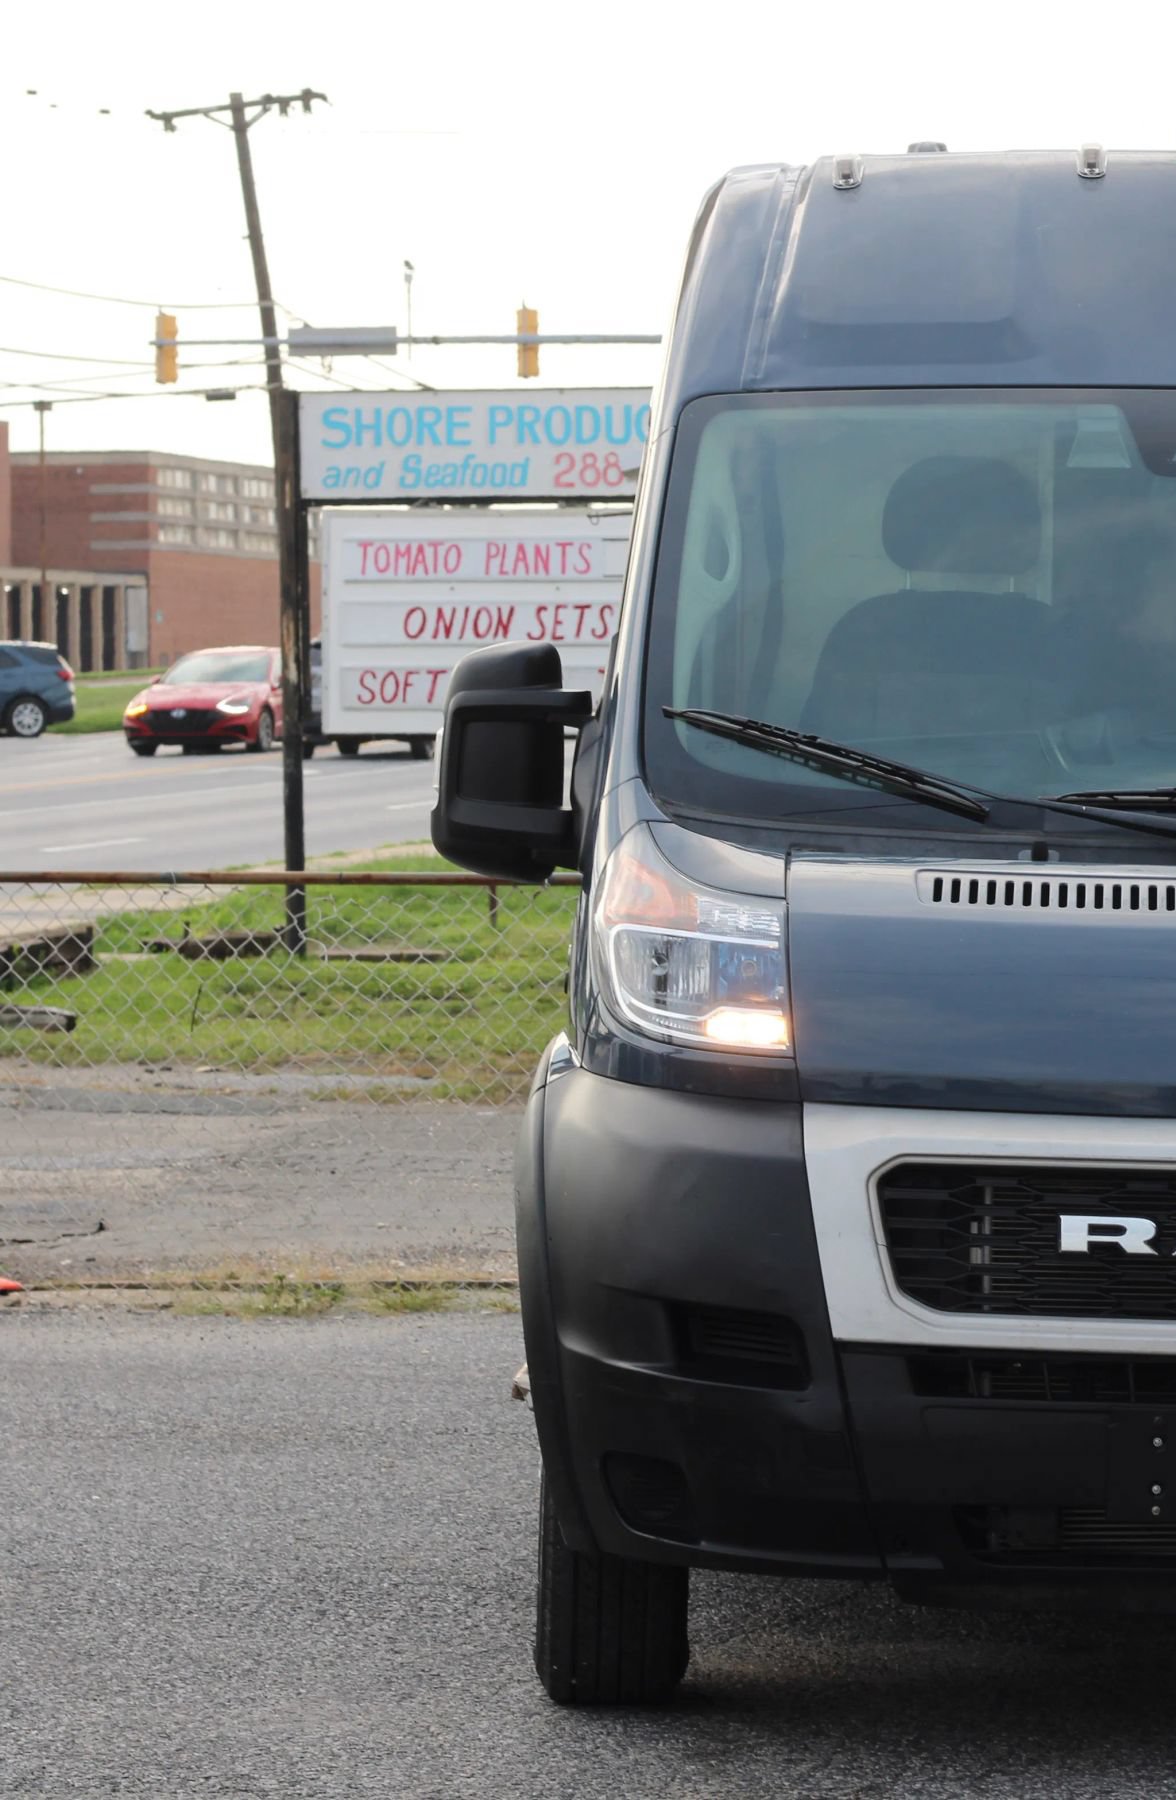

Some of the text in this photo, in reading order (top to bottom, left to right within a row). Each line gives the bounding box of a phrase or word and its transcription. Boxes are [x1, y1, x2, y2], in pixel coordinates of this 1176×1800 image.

[320, 405, 473, 449] SHORE
[321, 451, 625, 490] and Seafood 288
[356, 540, 593, 577] TOMATO PLANTS
[403, 603, 615, 641] ONION SETS
[356, 669, 447, 705] SOFT
